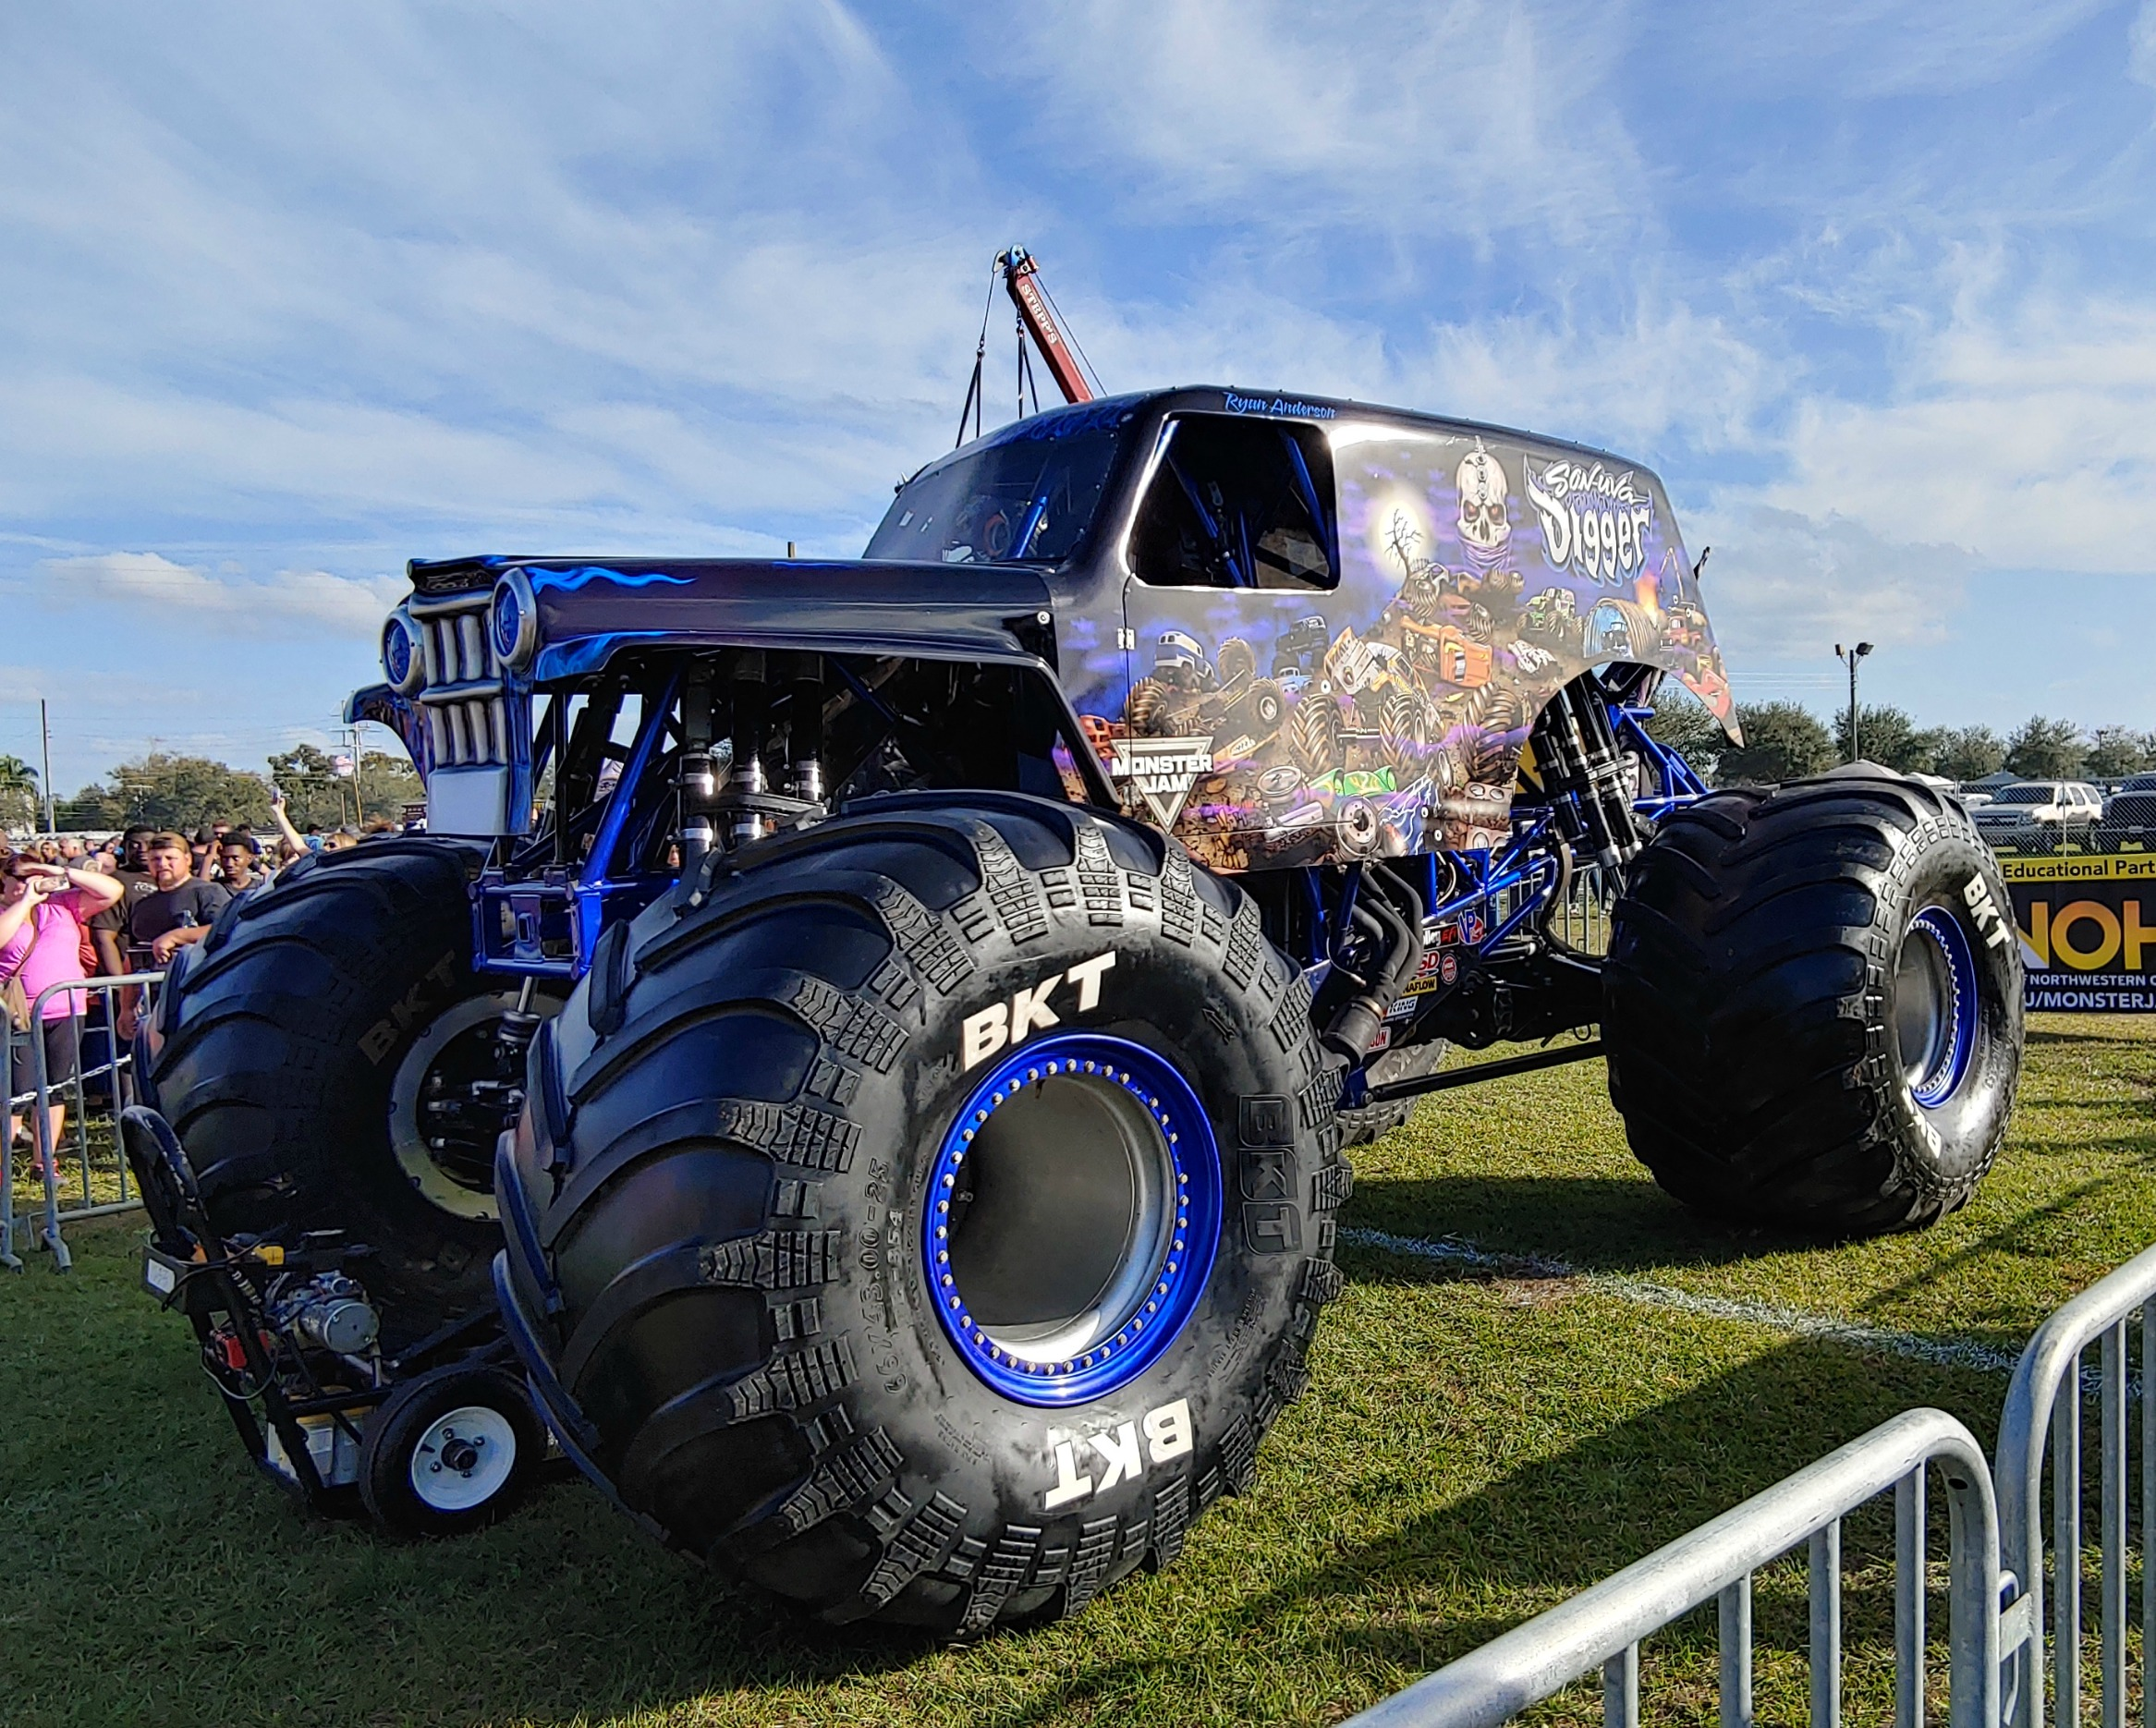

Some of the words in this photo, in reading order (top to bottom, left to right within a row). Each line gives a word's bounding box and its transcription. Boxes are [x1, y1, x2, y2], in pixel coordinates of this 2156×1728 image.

[1222, 392, 1268, 414] Ryan
[1270, 398, 1337, 419] Anderson
[1527, 472, 1650, 578] Digger
[1112, 753, 1212, 776] MONSTER
[1143, 774, 1189, 793] JAM
[2002, 859, 2109, 878] Educational
[2115, 859, 2156, 875] Part
[1964, 871, 2011, 949] BKT
[1458, 909, 1476, 944] VP
[2029, 974, 2146, 986] NORTHWESTERN
[358, 950, 456, 1066] BKT
[963, 950, 1116, 1072] BKT
[1389, 1000, 1416, 1014] KING
[2025, 992, 2156, 1009] U/MONSTERJ
[1246, 1098, 1296, 1250] BKT
[1045, 1398, 1194, 1510] BKT
